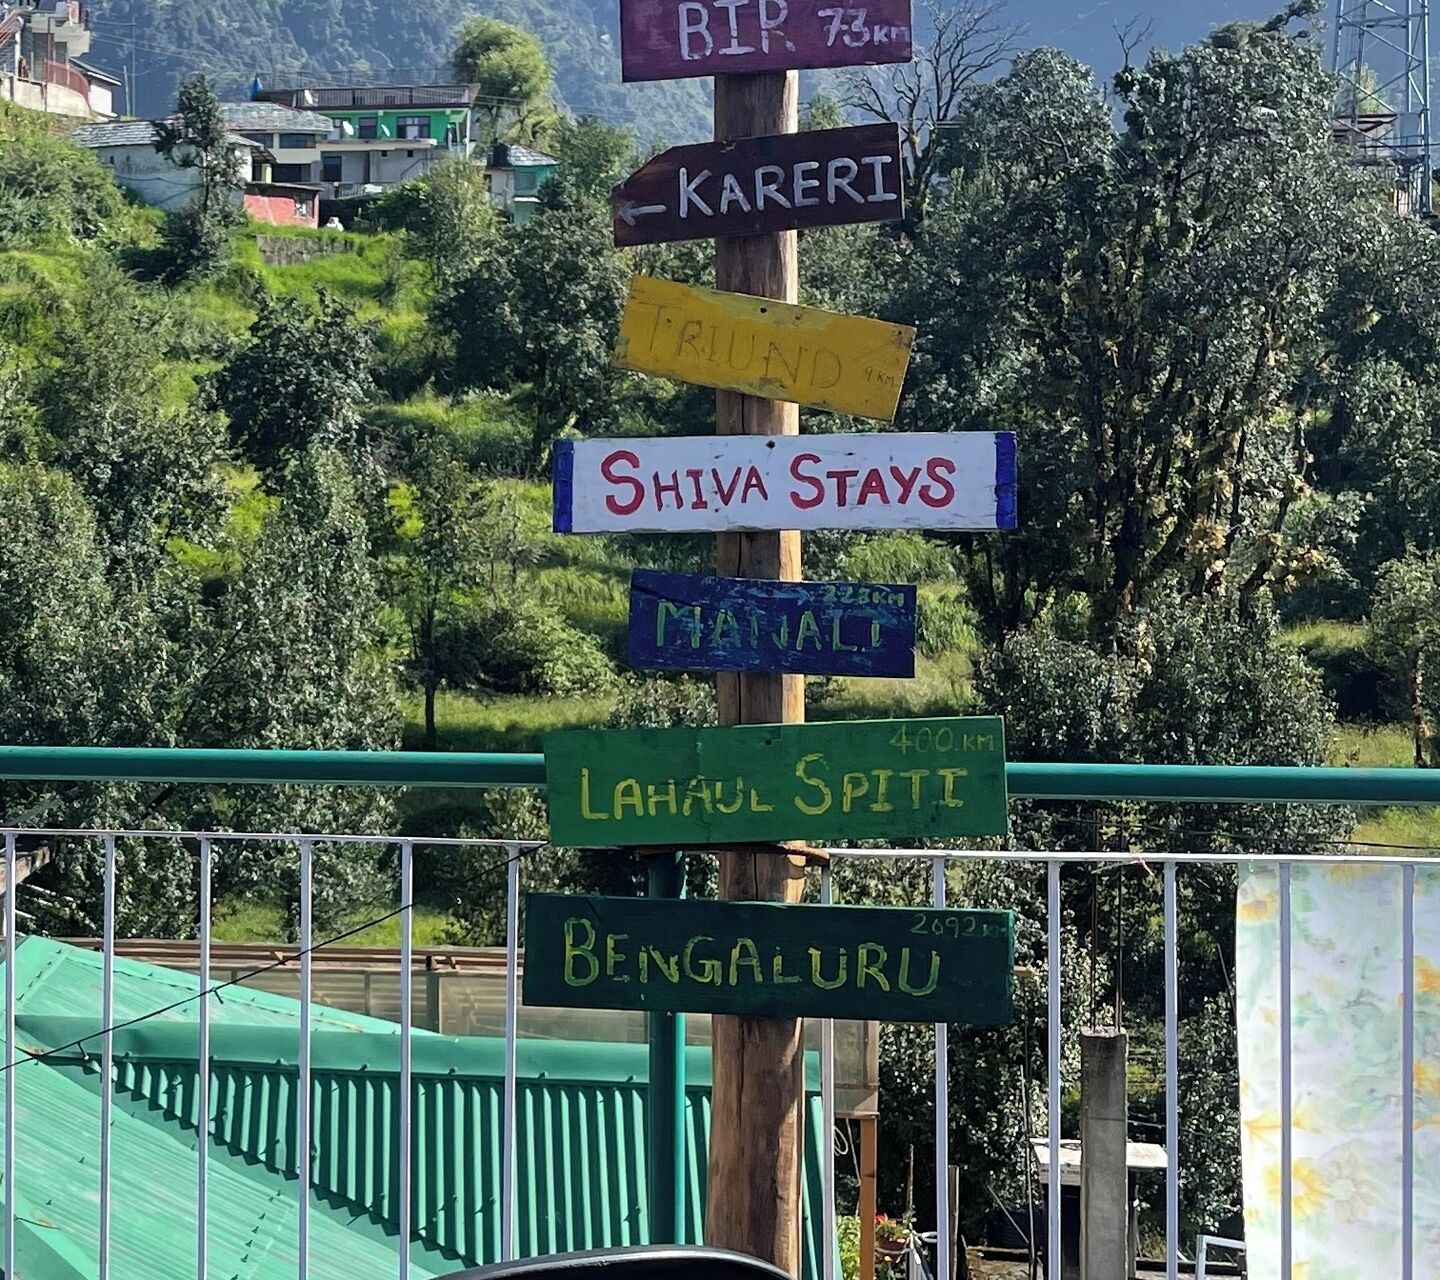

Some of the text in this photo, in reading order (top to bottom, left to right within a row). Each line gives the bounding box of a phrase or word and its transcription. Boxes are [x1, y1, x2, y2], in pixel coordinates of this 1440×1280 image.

[678, 154, 898, 219] KARERI
[638, 301, 843, 389] TRIUND
[600, 449, 957, 516] SHIVA STAYS
[580, 753, 969, 820] LAHAUL SPITI
[563, 918, 941, 997] BENGALURU
